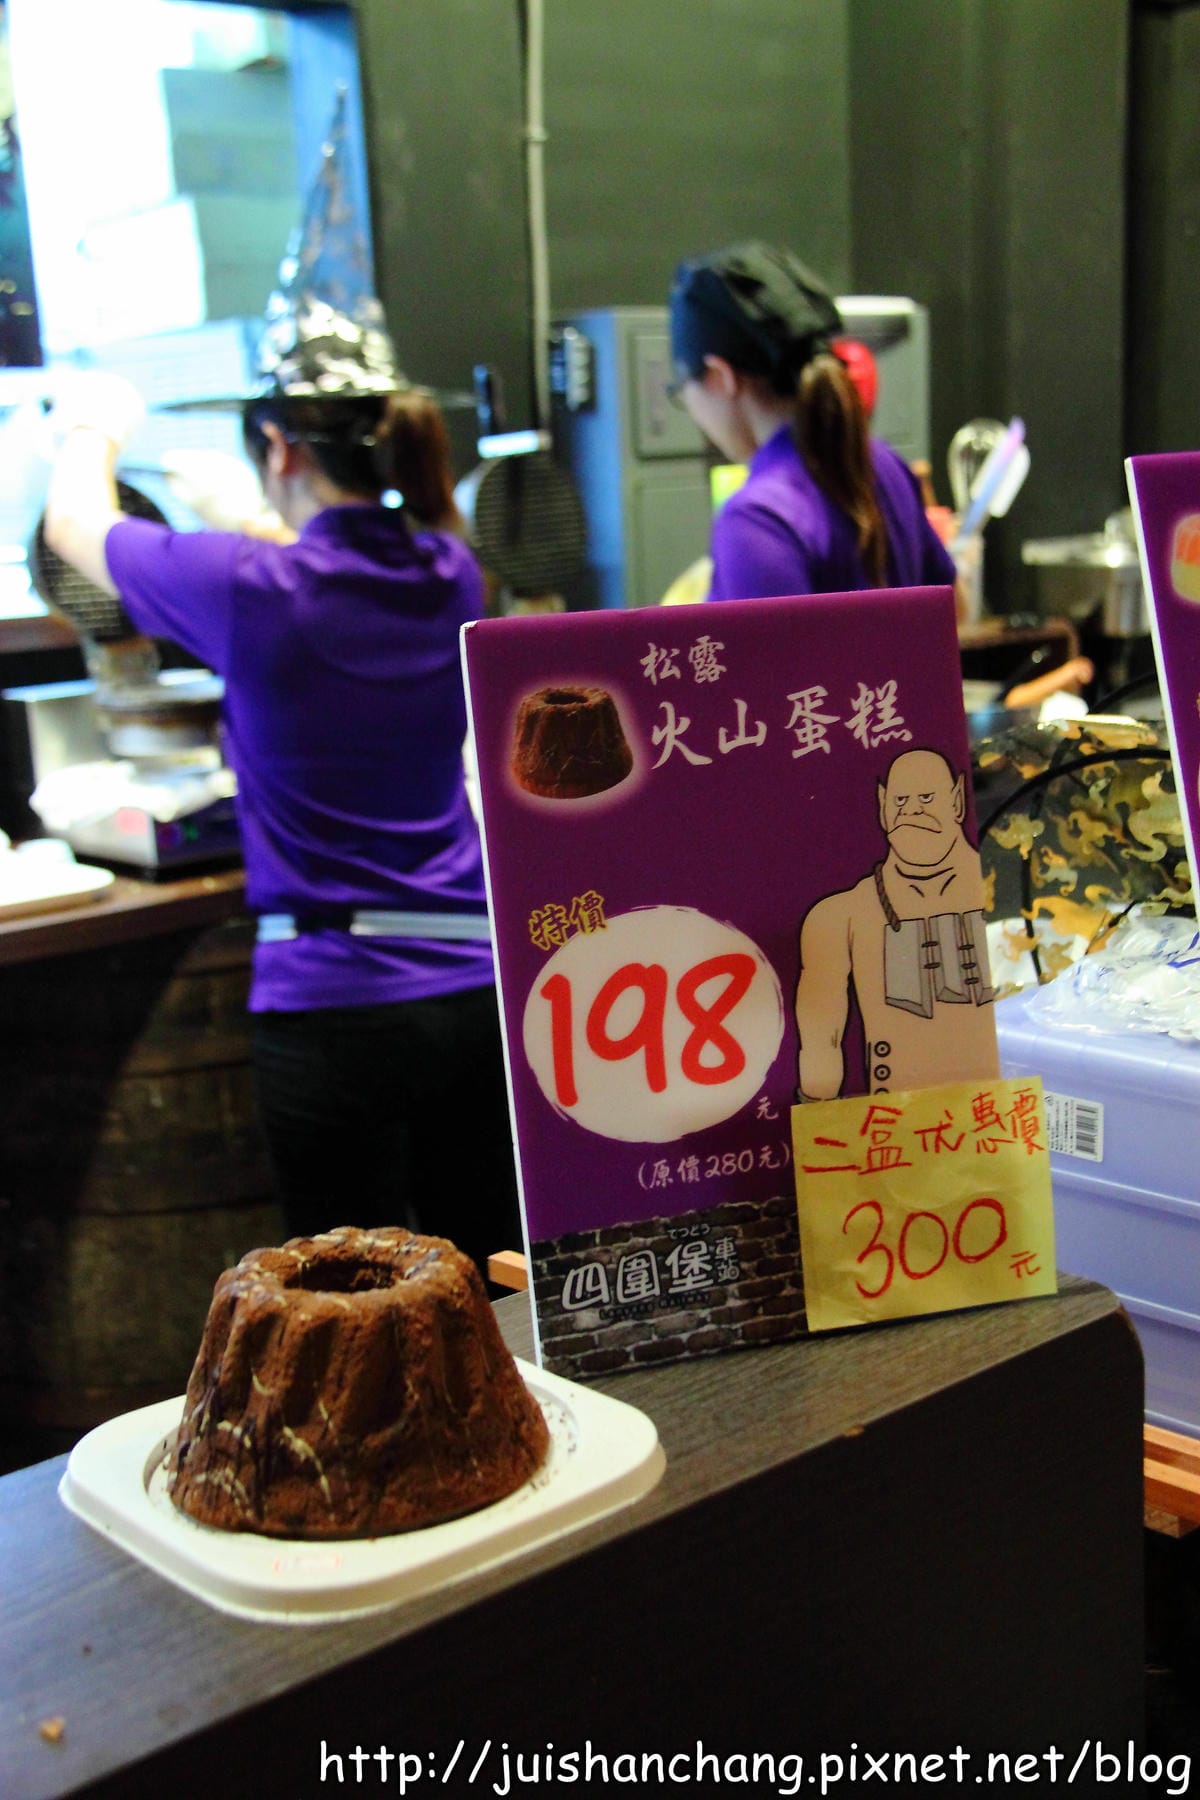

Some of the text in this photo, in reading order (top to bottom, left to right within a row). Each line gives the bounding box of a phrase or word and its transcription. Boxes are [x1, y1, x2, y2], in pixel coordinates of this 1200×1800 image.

[640, 635, 727, 685] 松露
[651, 680, 913, 769] 火山蛋糕
[529, 890, 607, 950] 特價
[540, 953, 757, 1107] 198
[756, 1096, 779, 1120] 元
[638, 1141, 790, 1190] (原價280元)
